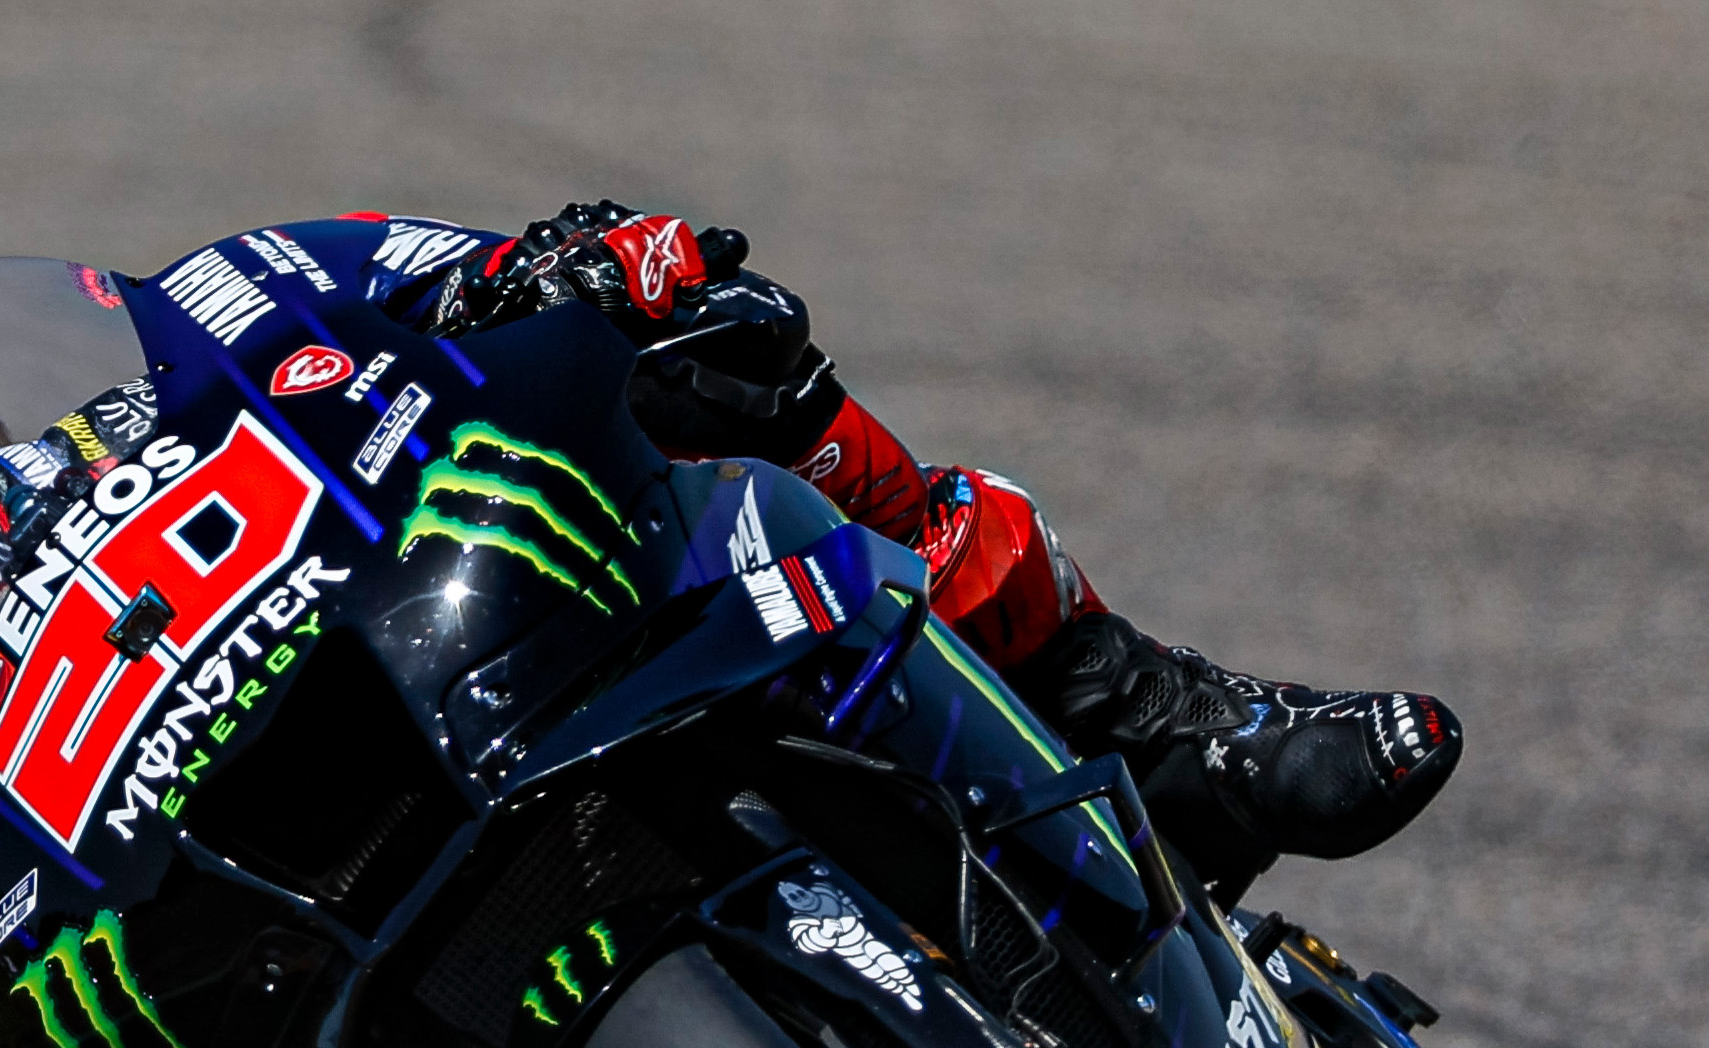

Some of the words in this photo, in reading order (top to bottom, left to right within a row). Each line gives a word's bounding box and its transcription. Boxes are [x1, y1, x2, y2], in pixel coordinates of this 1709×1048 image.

[262, 230, 319, 270] LIMITS
[306, 269, 338, 293] THE
[160, 248, 276, 345] YAMAHA
[344, 351, 397, 402] msi
[362, 392, 413, 464] BLUE
[374, 402, 420, 472] CORE
[105, 556, 351, 840] MONSTER
[161, 610, 322, 819] ENERGY
